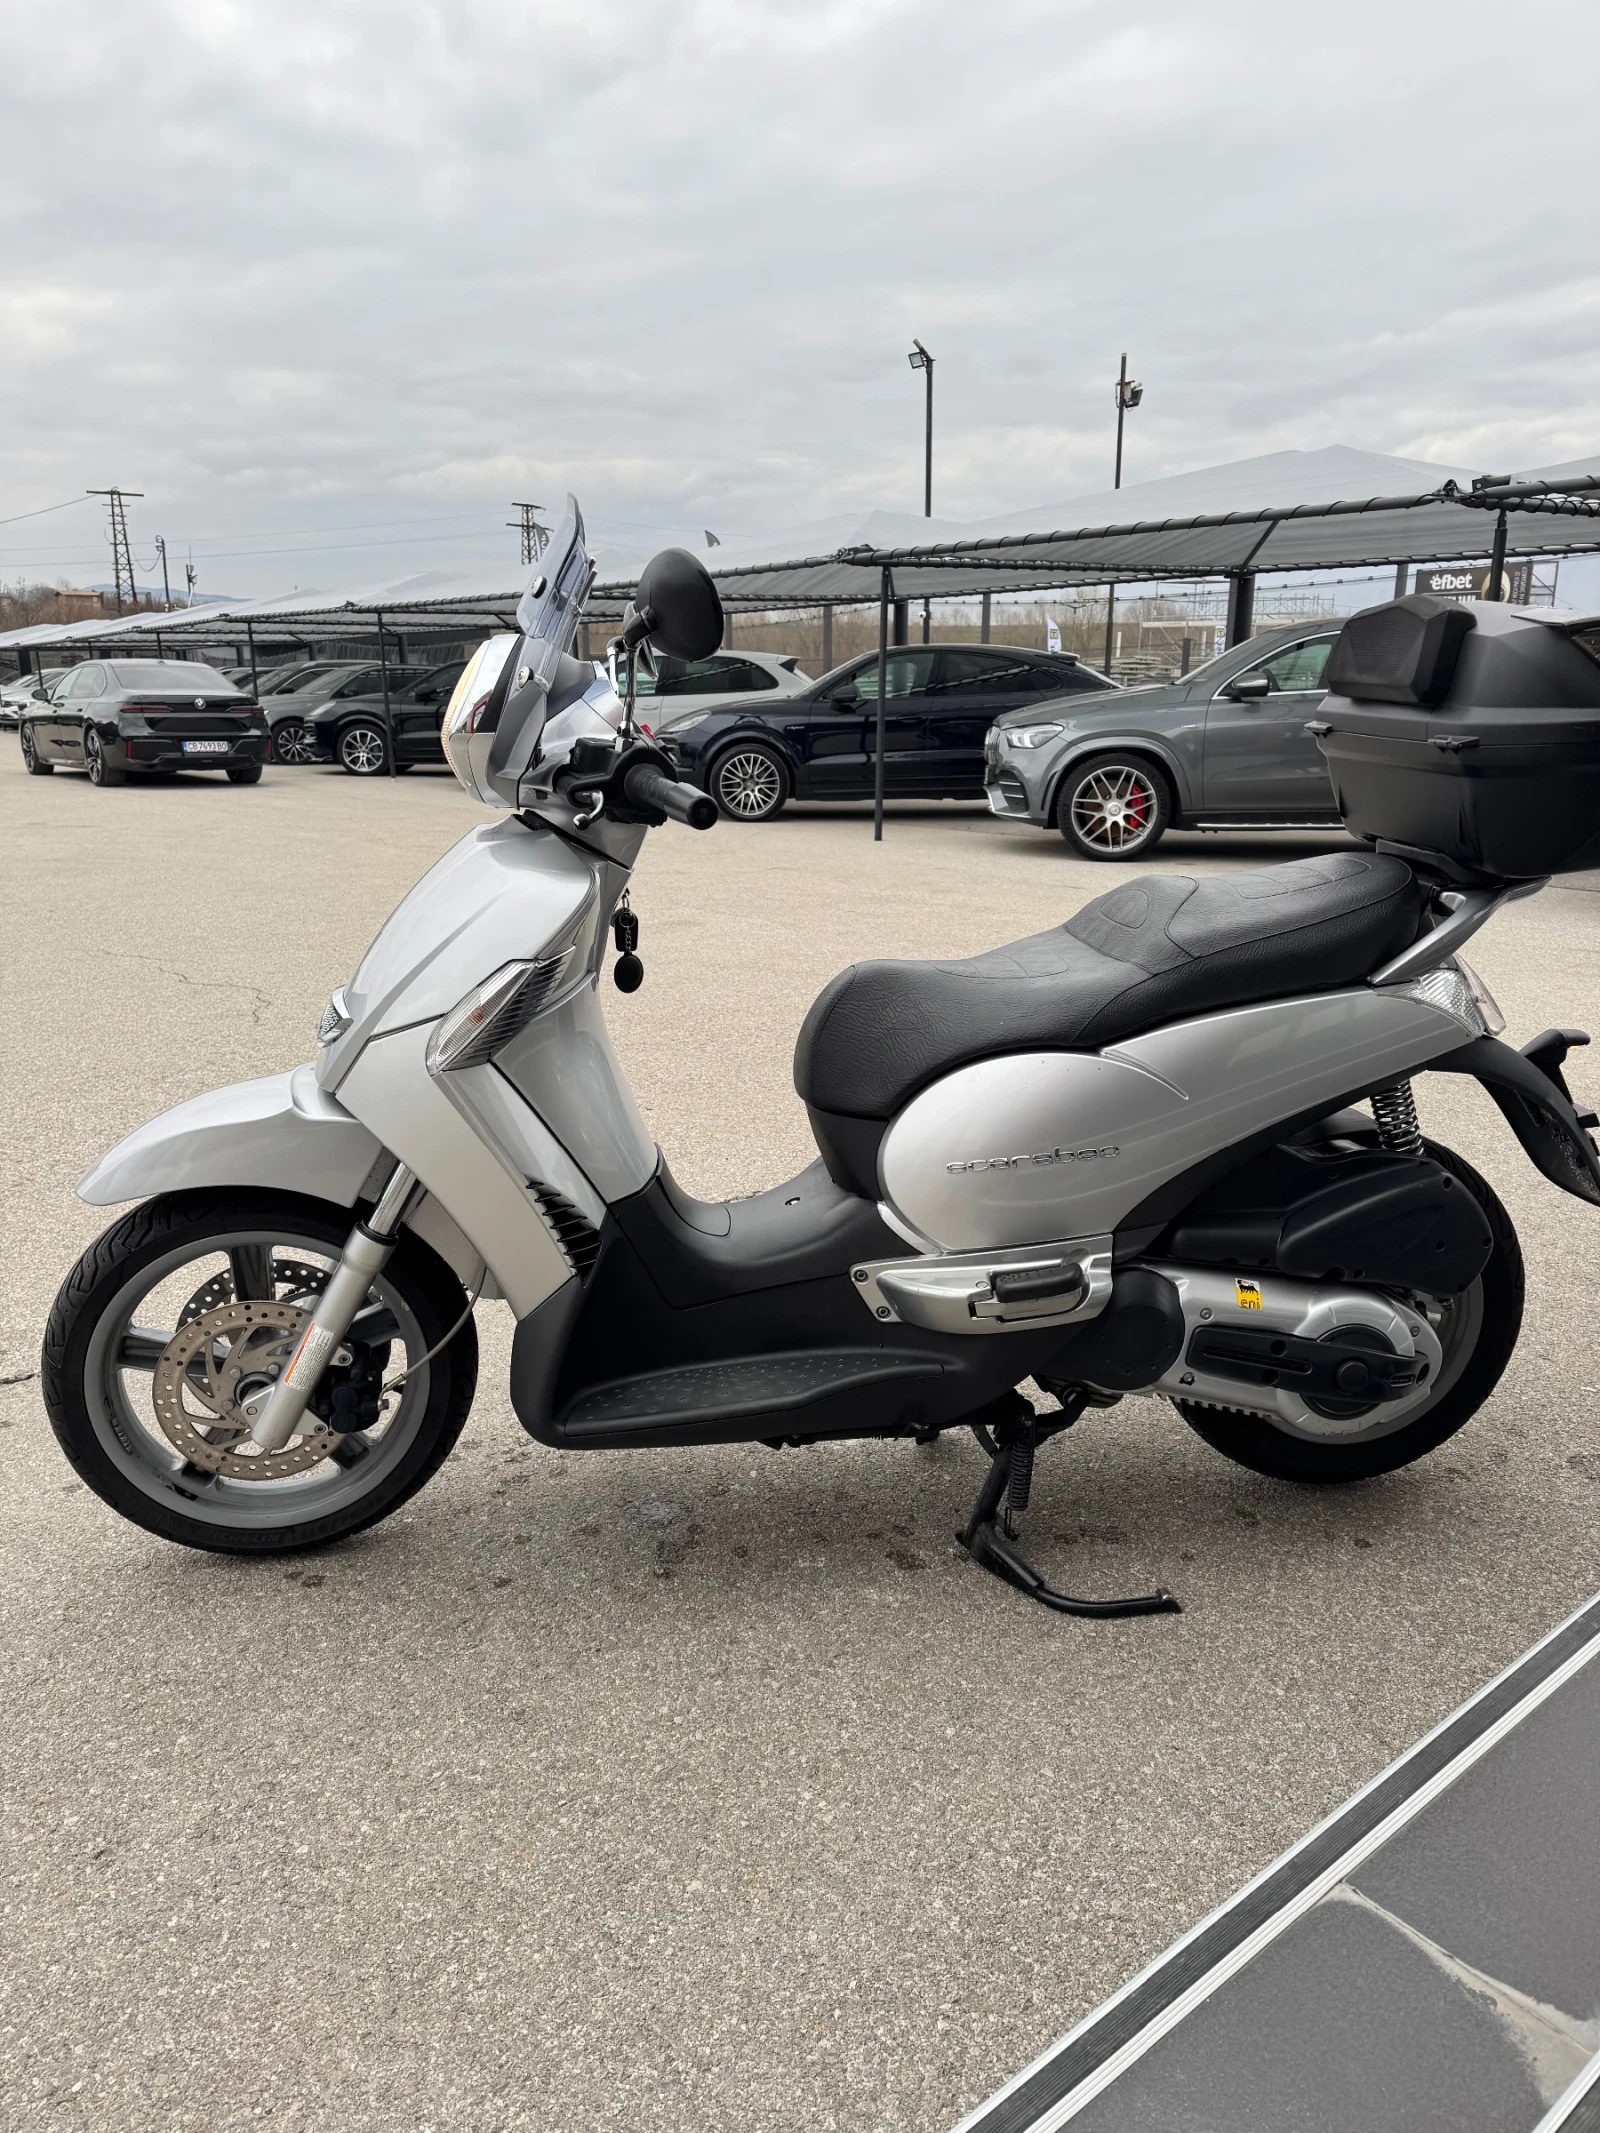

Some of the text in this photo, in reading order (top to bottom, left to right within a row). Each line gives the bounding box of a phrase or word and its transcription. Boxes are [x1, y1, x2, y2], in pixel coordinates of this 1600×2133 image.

[1430, 573, 1473, 590] efbet
[946, 1146, 1120, 1174] scarabeo
[1240, 1298, 1260, 1310] eni
